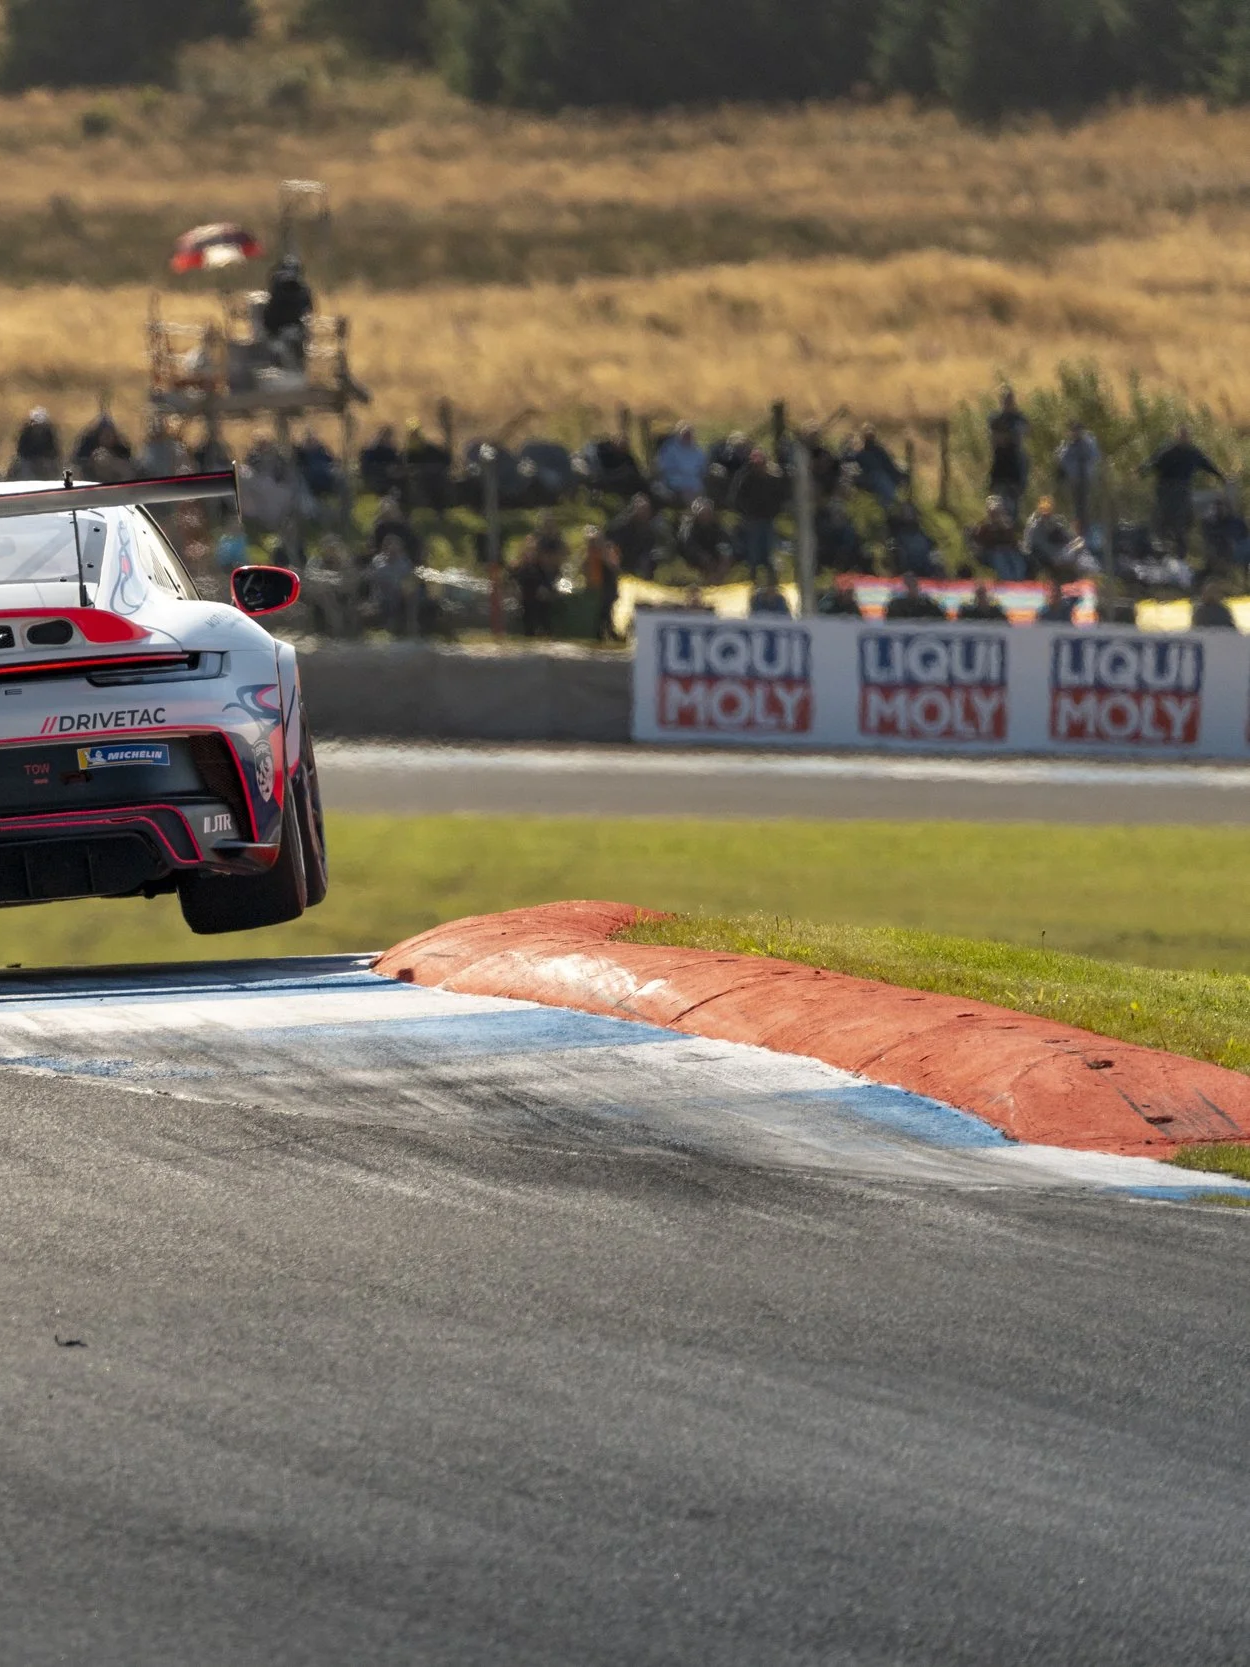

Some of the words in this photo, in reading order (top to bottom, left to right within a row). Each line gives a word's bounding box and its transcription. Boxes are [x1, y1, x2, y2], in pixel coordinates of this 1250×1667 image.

[665, 630, 804, 675] LIQUI
[863, 637, 1000, 682] LIQUI
[1058, 640, 1196, 688] LIQUI
[665, 680, 803, 727] MOLY
[866, 686, 1000, 735] MOLY
[1057, 692, 1193, 741] MOLY
[23, 763, 50, 775] TOW
[107, 750, 163, 761] MICHELIN
